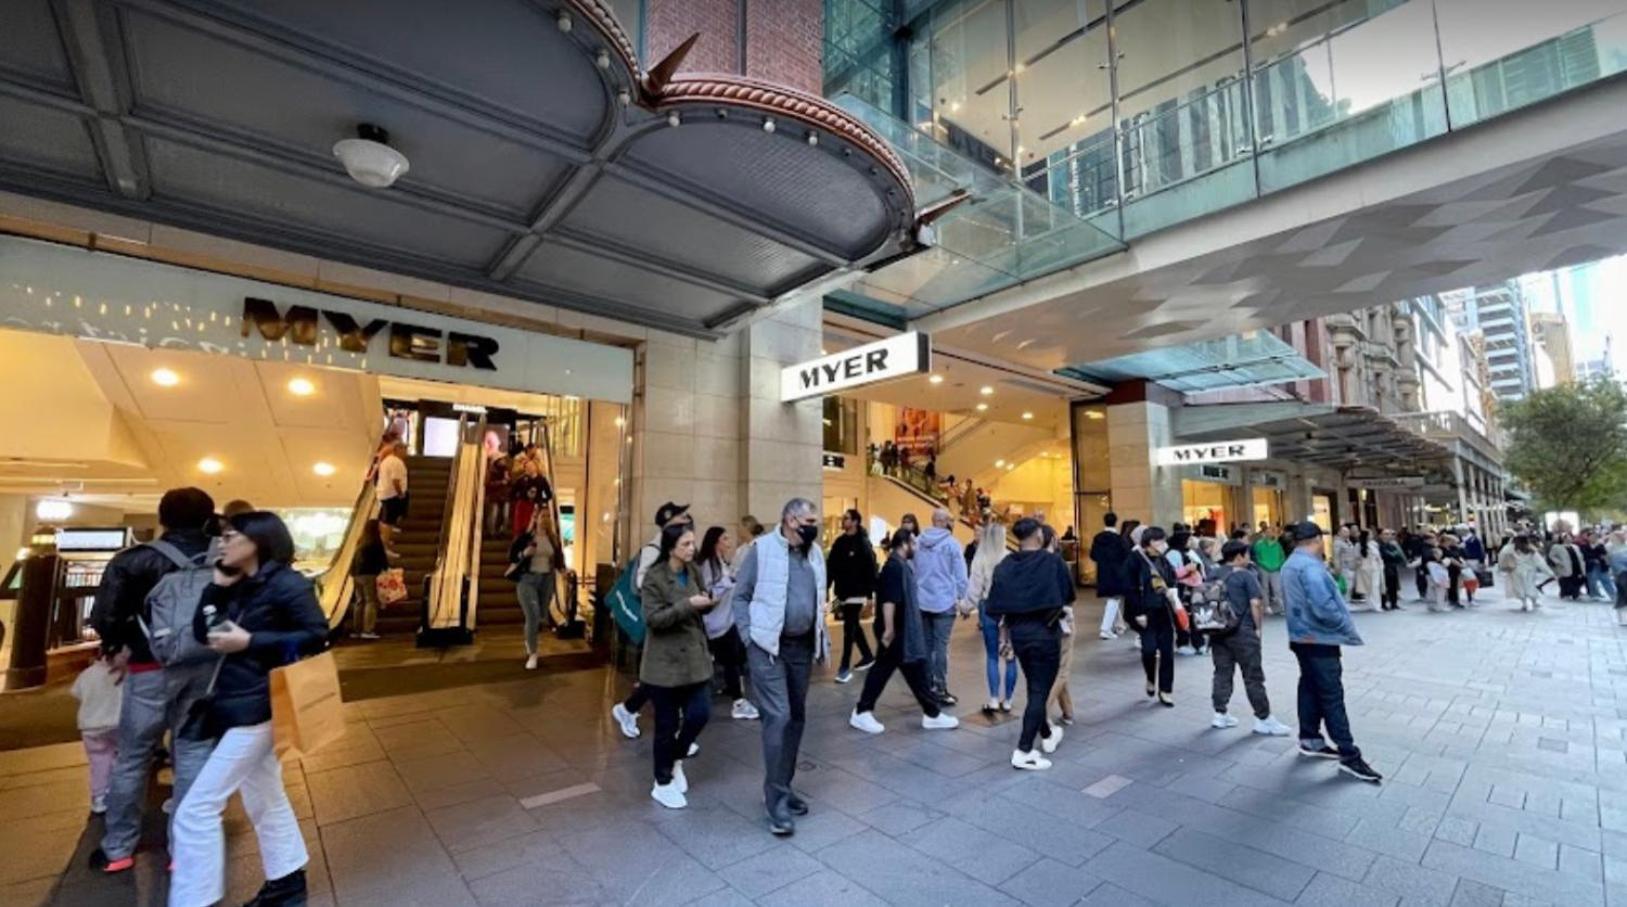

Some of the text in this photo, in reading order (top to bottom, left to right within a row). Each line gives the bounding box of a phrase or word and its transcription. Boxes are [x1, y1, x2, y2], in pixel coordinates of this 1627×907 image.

[241, 297, 499, 371] MYER
[800, 348, 889, 389] MYER
[1173, 445, 1245, 460] MYER
